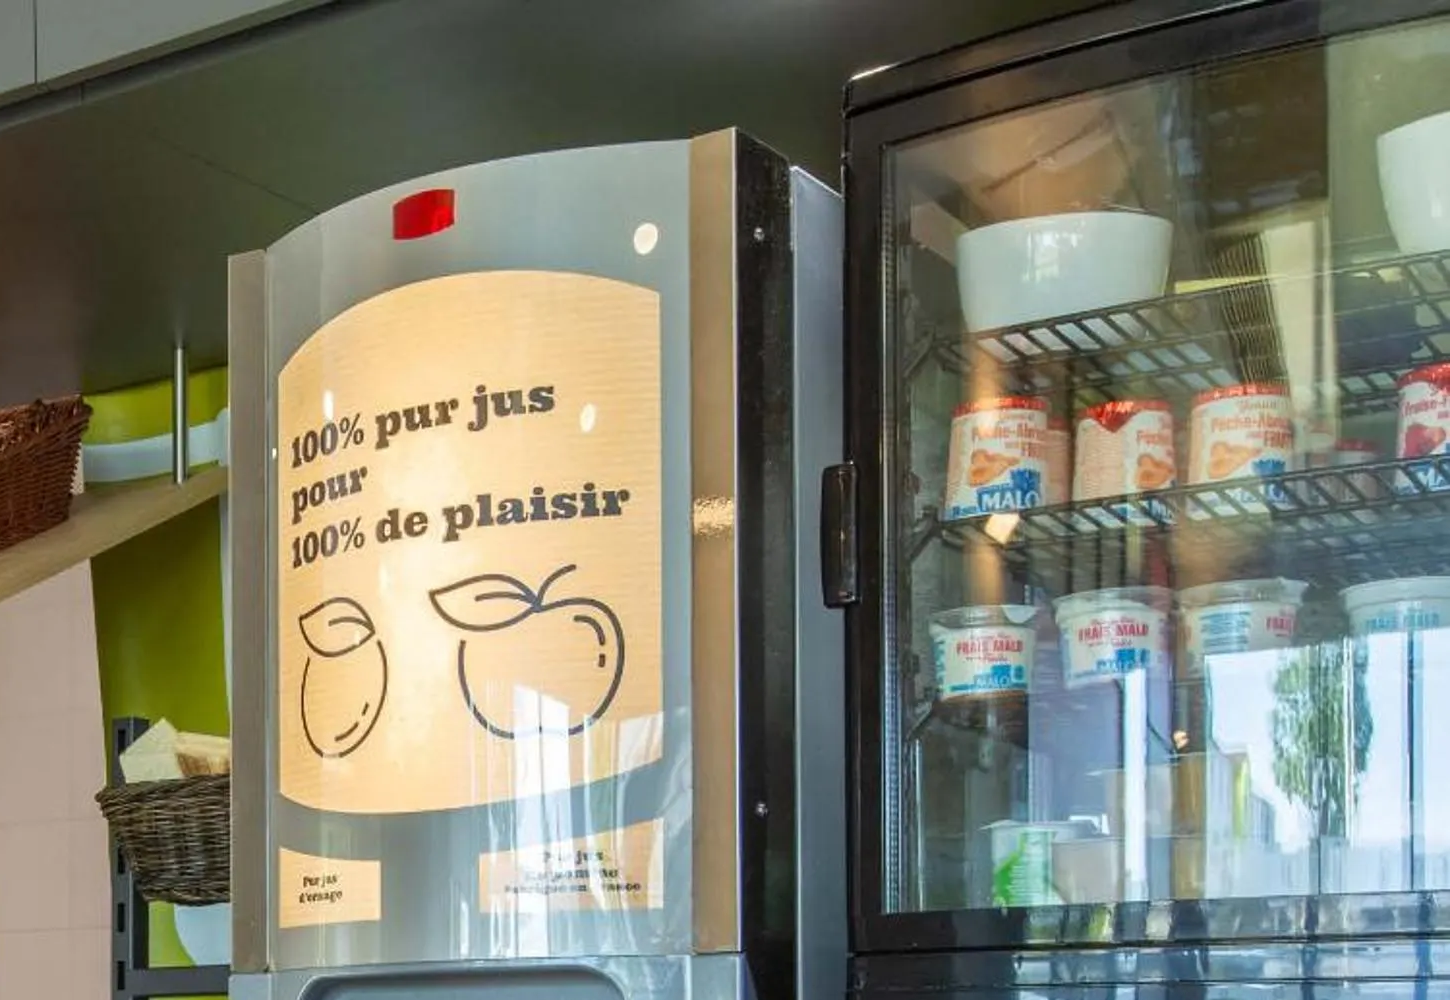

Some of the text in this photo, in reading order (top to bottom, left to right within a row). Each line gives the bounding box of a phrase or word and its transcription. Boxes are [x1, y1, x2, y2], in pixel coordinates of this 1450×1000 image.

[291, 384, 556, 468] 100% pur jus
[291, 464, 368, 525] pour
[292, 482, 631, 569] 100% de plaisir
[979, 491, 1041, 512] MALO
